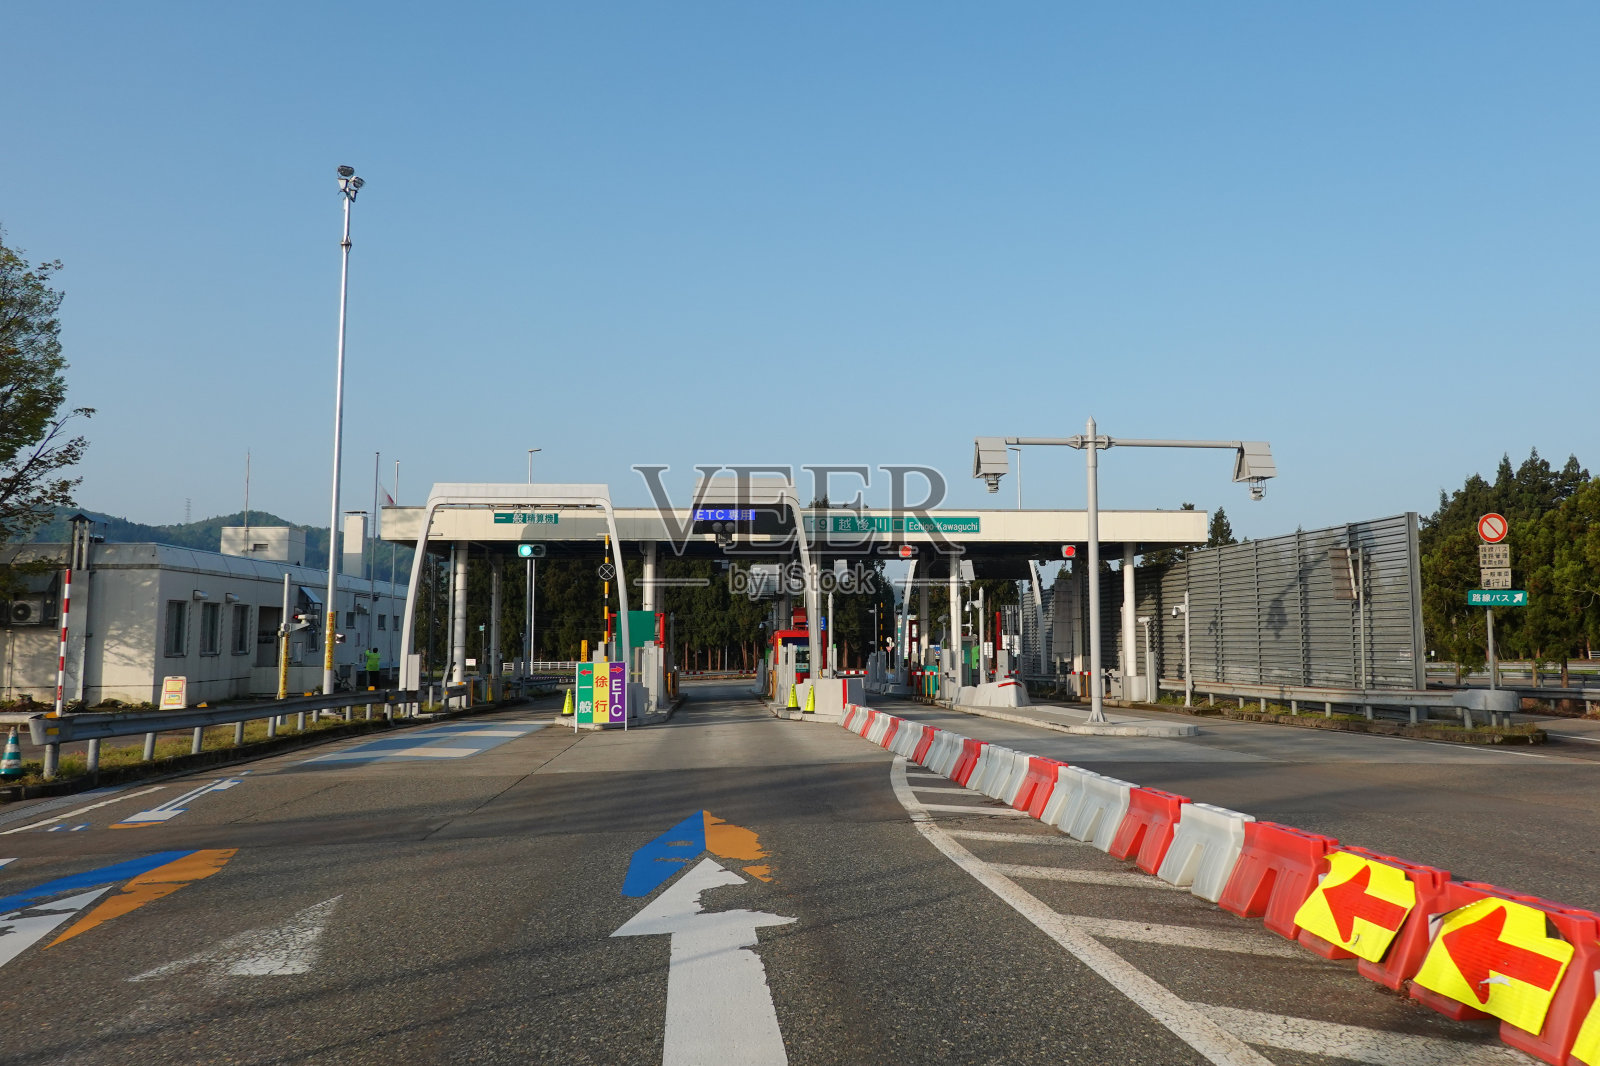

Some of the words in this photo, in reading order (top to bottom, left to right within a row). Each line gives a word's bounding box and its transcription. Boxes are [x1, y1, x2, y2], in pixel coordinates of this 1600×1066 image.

[1472, 593, 1509, 602] 路線バス
[579, 685, 592, 714] 一般
[595, 675, 608, 713] 徐行
[611, 679, 622, 717] ETC
